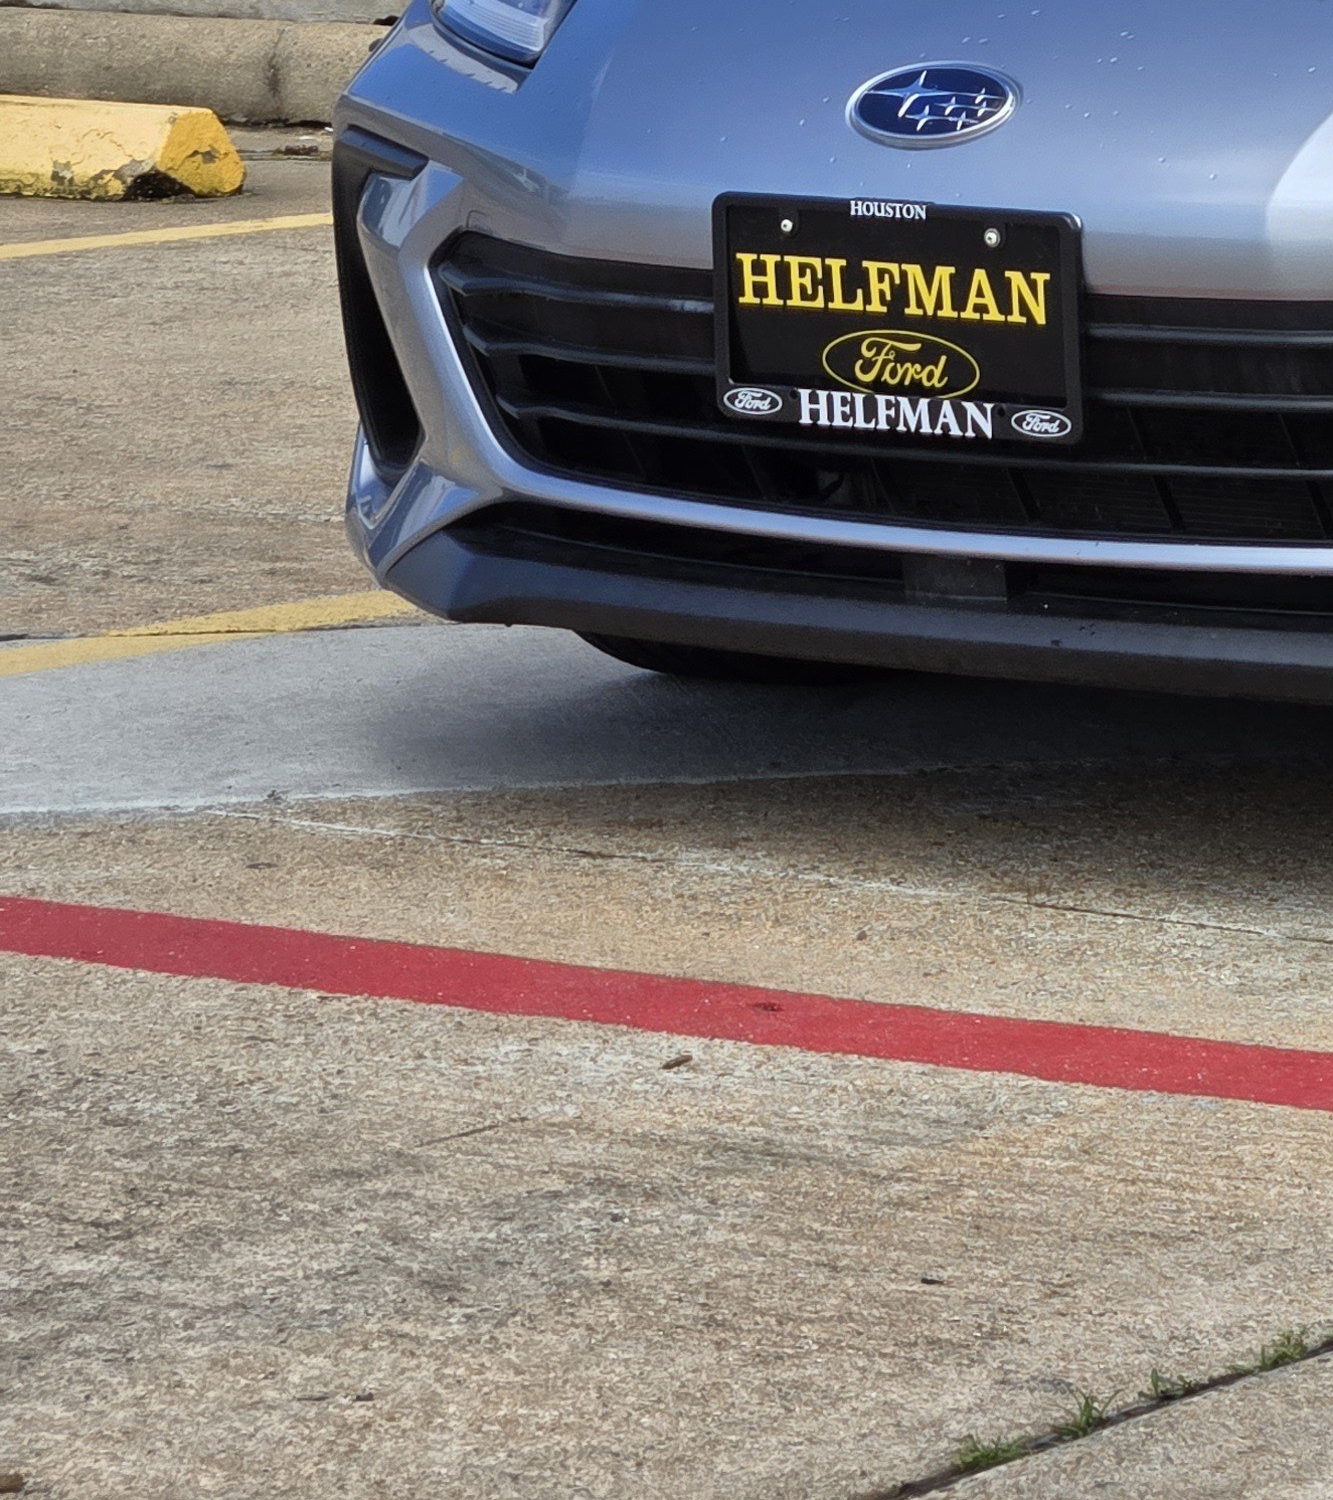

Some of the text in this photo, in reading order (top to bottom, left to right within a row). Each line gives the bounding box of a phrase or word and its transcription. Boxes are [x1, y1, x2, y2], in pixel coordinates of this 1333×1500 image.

[850, 200, 927, 220] HOUSTON
[735, 252, 1051, 325] HELFMAN
[854, 337, 949, 388] Ford
[733, 390, 771, 411] Ford
[797, 388, 995, 440] HELFMAN
[1021, 412, 1060, 434] Ford
